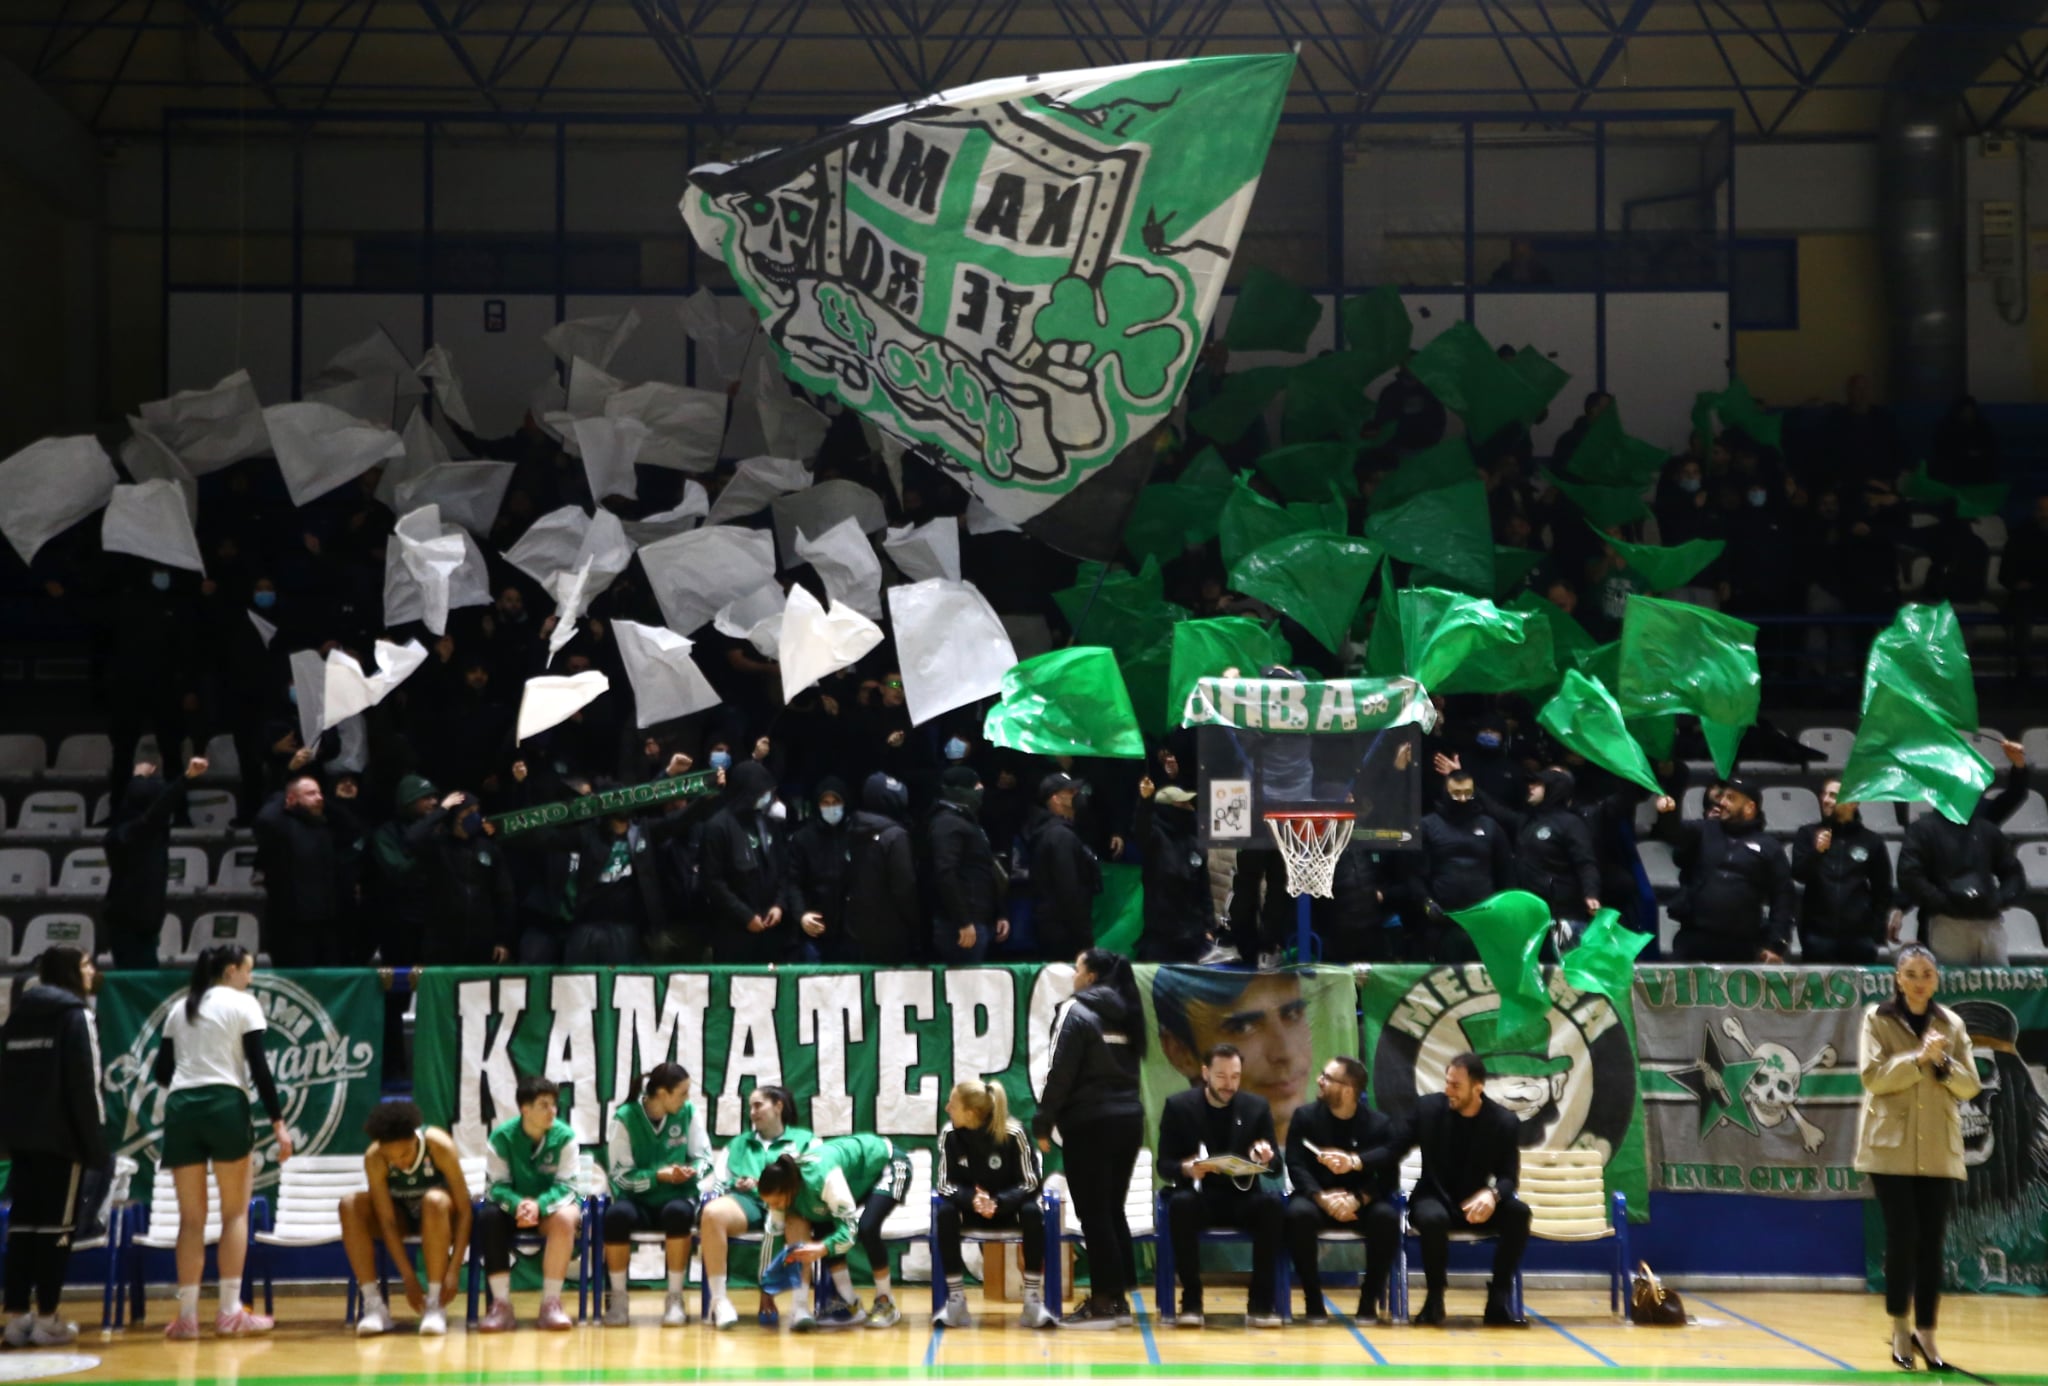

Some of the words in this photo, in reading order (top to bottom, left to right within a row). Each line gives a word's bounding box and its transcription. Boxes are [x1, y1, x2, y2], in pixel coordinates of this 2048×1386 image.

[1634, 964, 1860, 1012] VIRONAS
[1749, 1164, 1821, 1193] GIVE
[1825, 1164, 1868, 1193] UP
